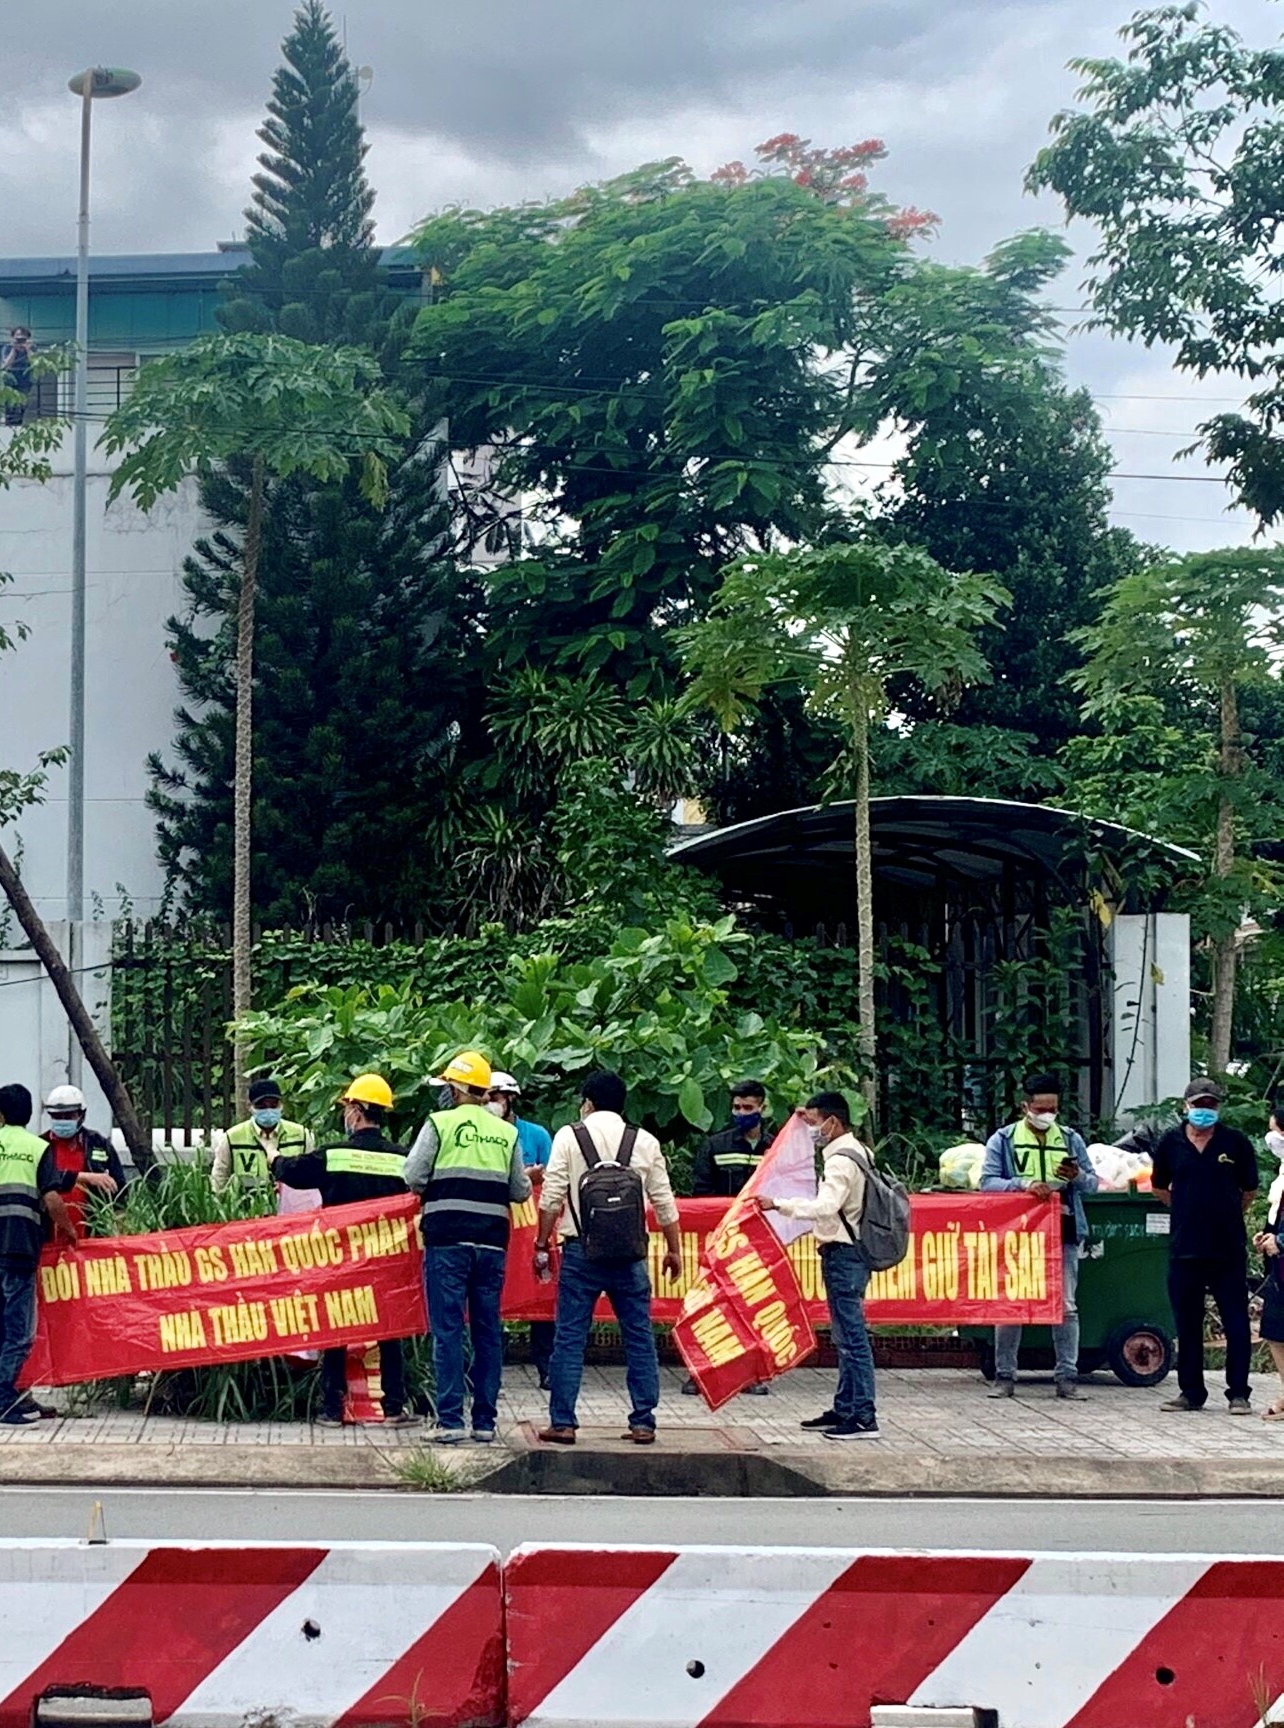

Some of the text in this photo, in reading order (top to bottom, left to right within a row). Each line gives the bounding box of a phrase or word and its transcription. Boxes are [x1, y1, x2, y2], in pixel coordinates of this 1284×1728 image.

[84, 1252, 132, 1297] NHÀ
[134, 1241, 192, 1291] THẦU
[194, 1245, 228, 1284] GS
[228, 1236, 278, 1279] HÀN
[279, 1219, 344, 1275] QUỐC
[921, 1220, 960, 1302] GIỮ
[963, 1220, 999, 1300] TÀI
[1004, 1214, 1047, 1302] SẢN
[159, 1285, 380, 1352] NHÀ THẦU VIỆT NAM
[690, 1307, 747, 1368] NAM
[751, 1299, 800, 1367] QUỐC
